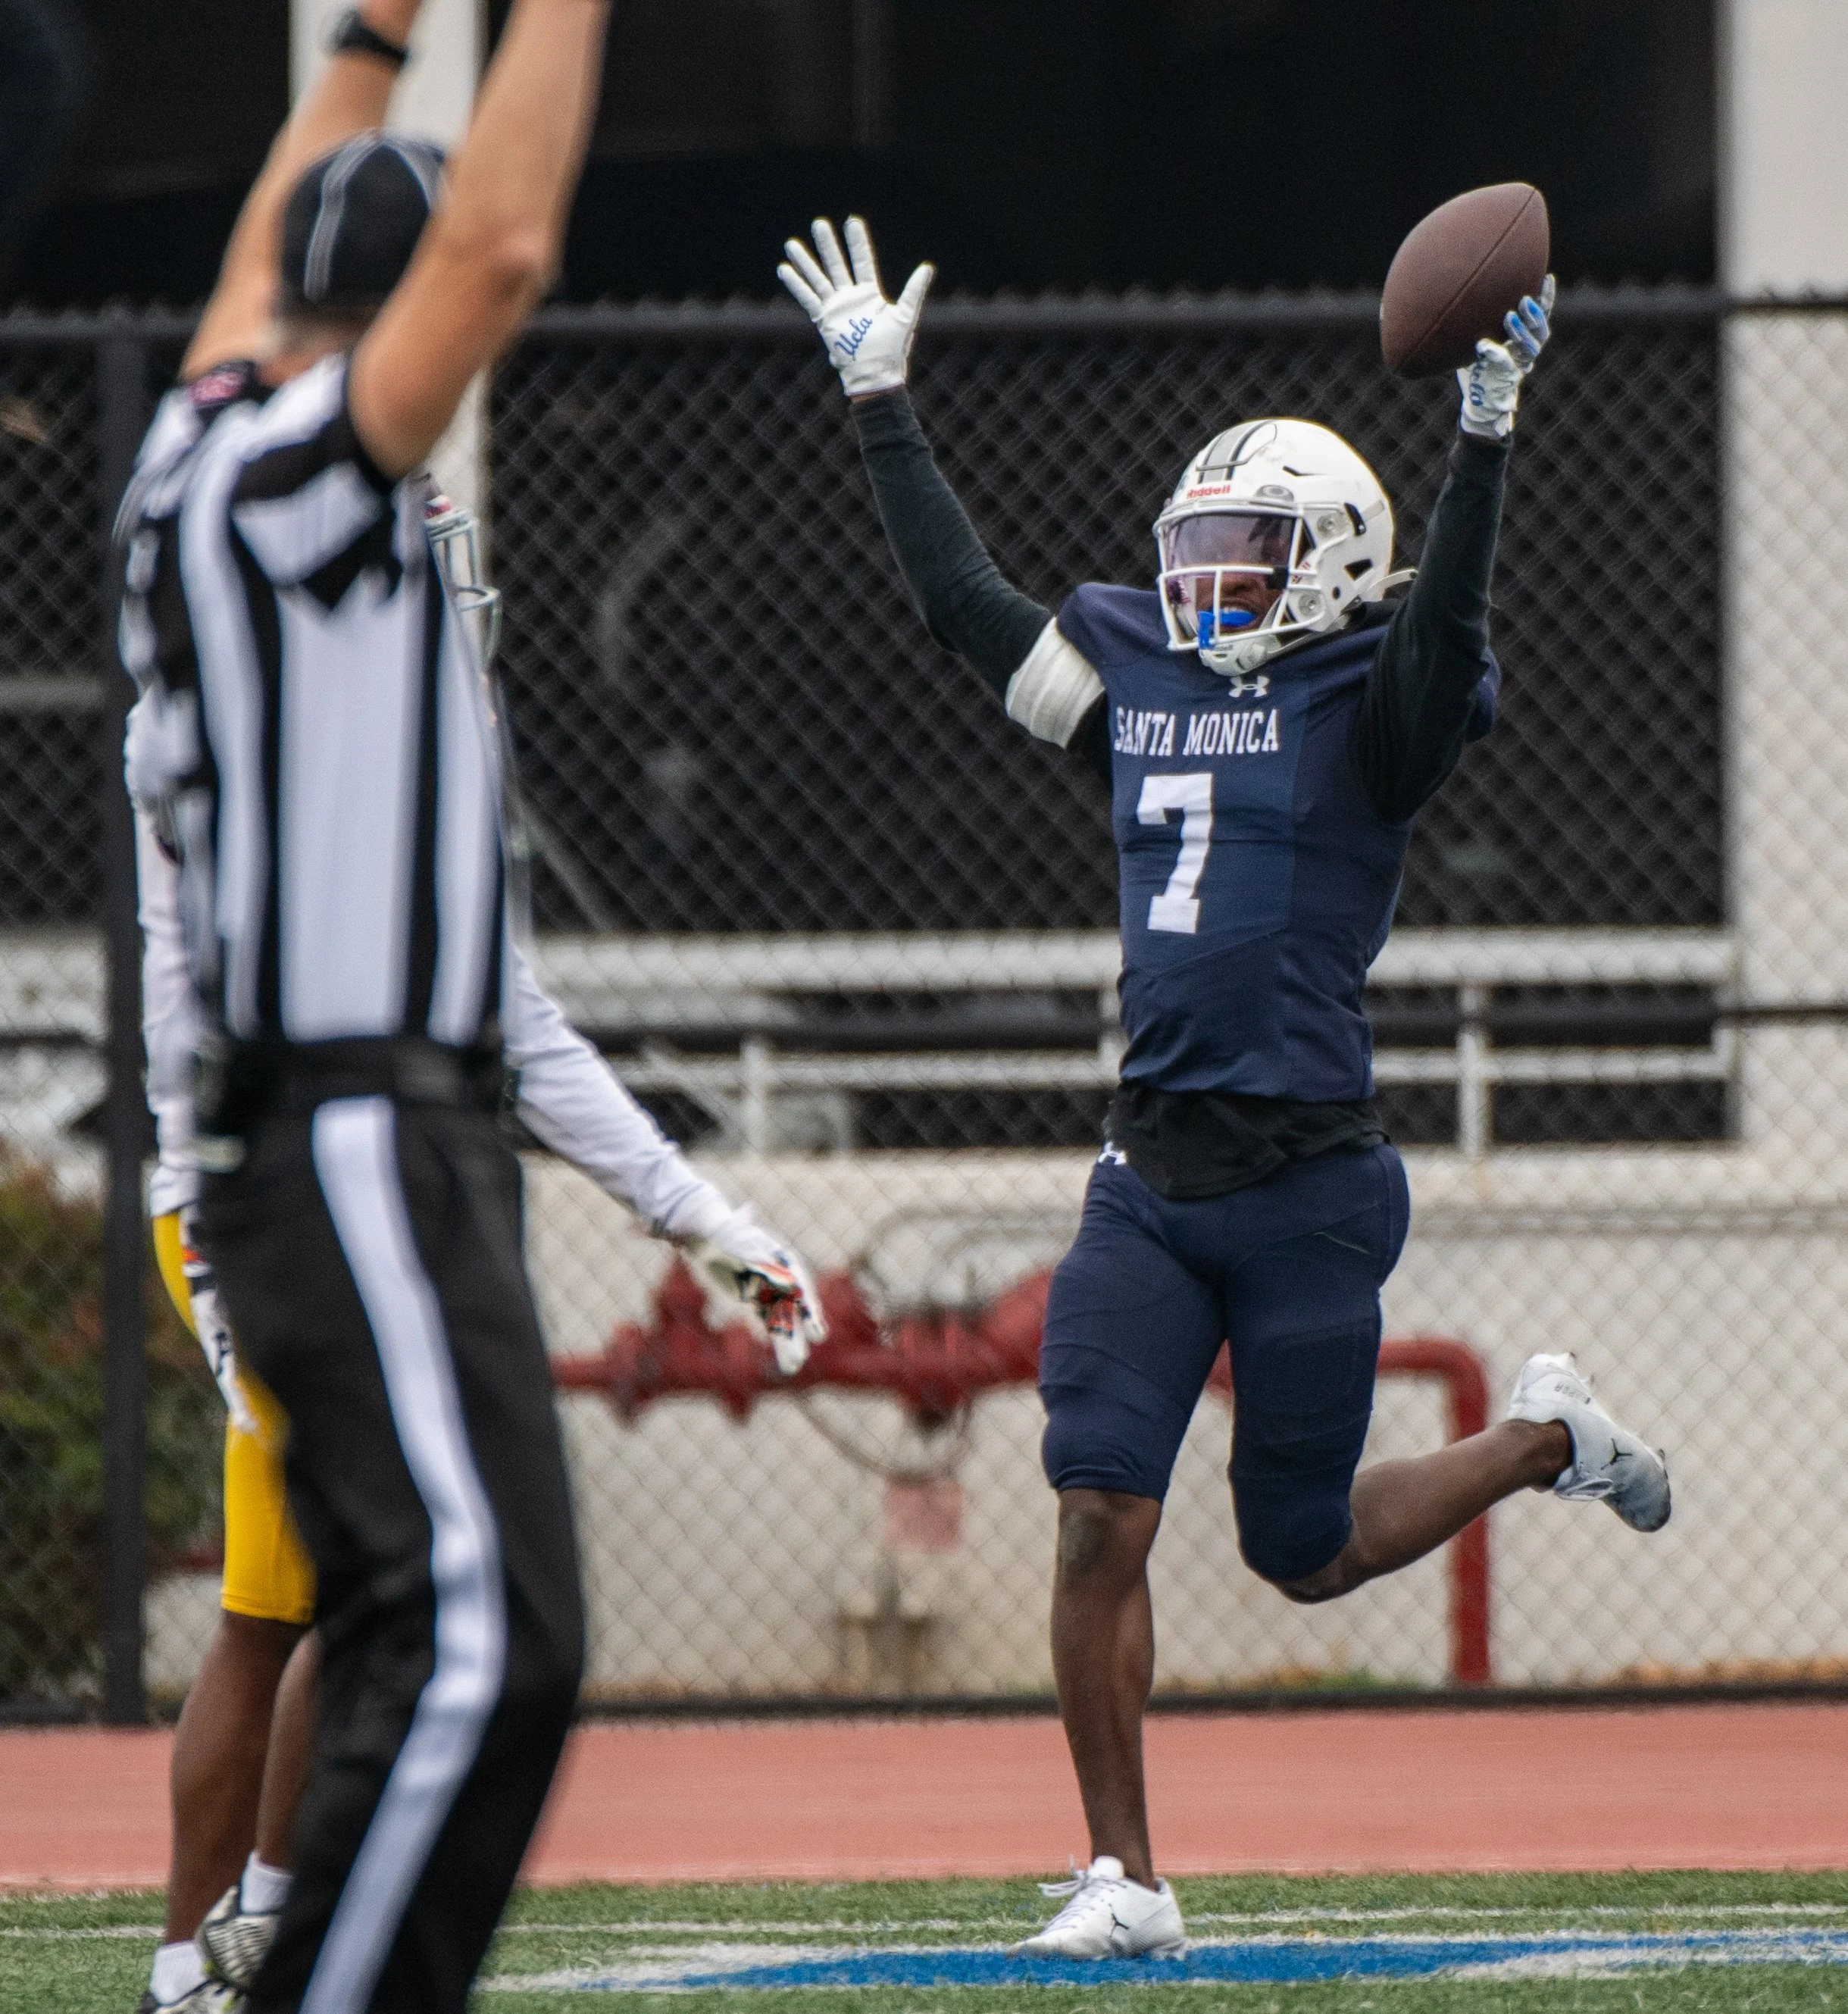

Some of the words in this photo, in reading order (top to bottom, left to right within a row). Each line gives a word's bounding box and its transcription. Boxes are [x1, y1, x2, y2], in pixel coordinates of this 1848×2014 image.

[1187, 484, 1231, 499] Riddell
[1114, 706, 1176, 756] SANTA
[1182, 708, 1279, 756] MONICA
[1137, 773, 1212, 934] 7
